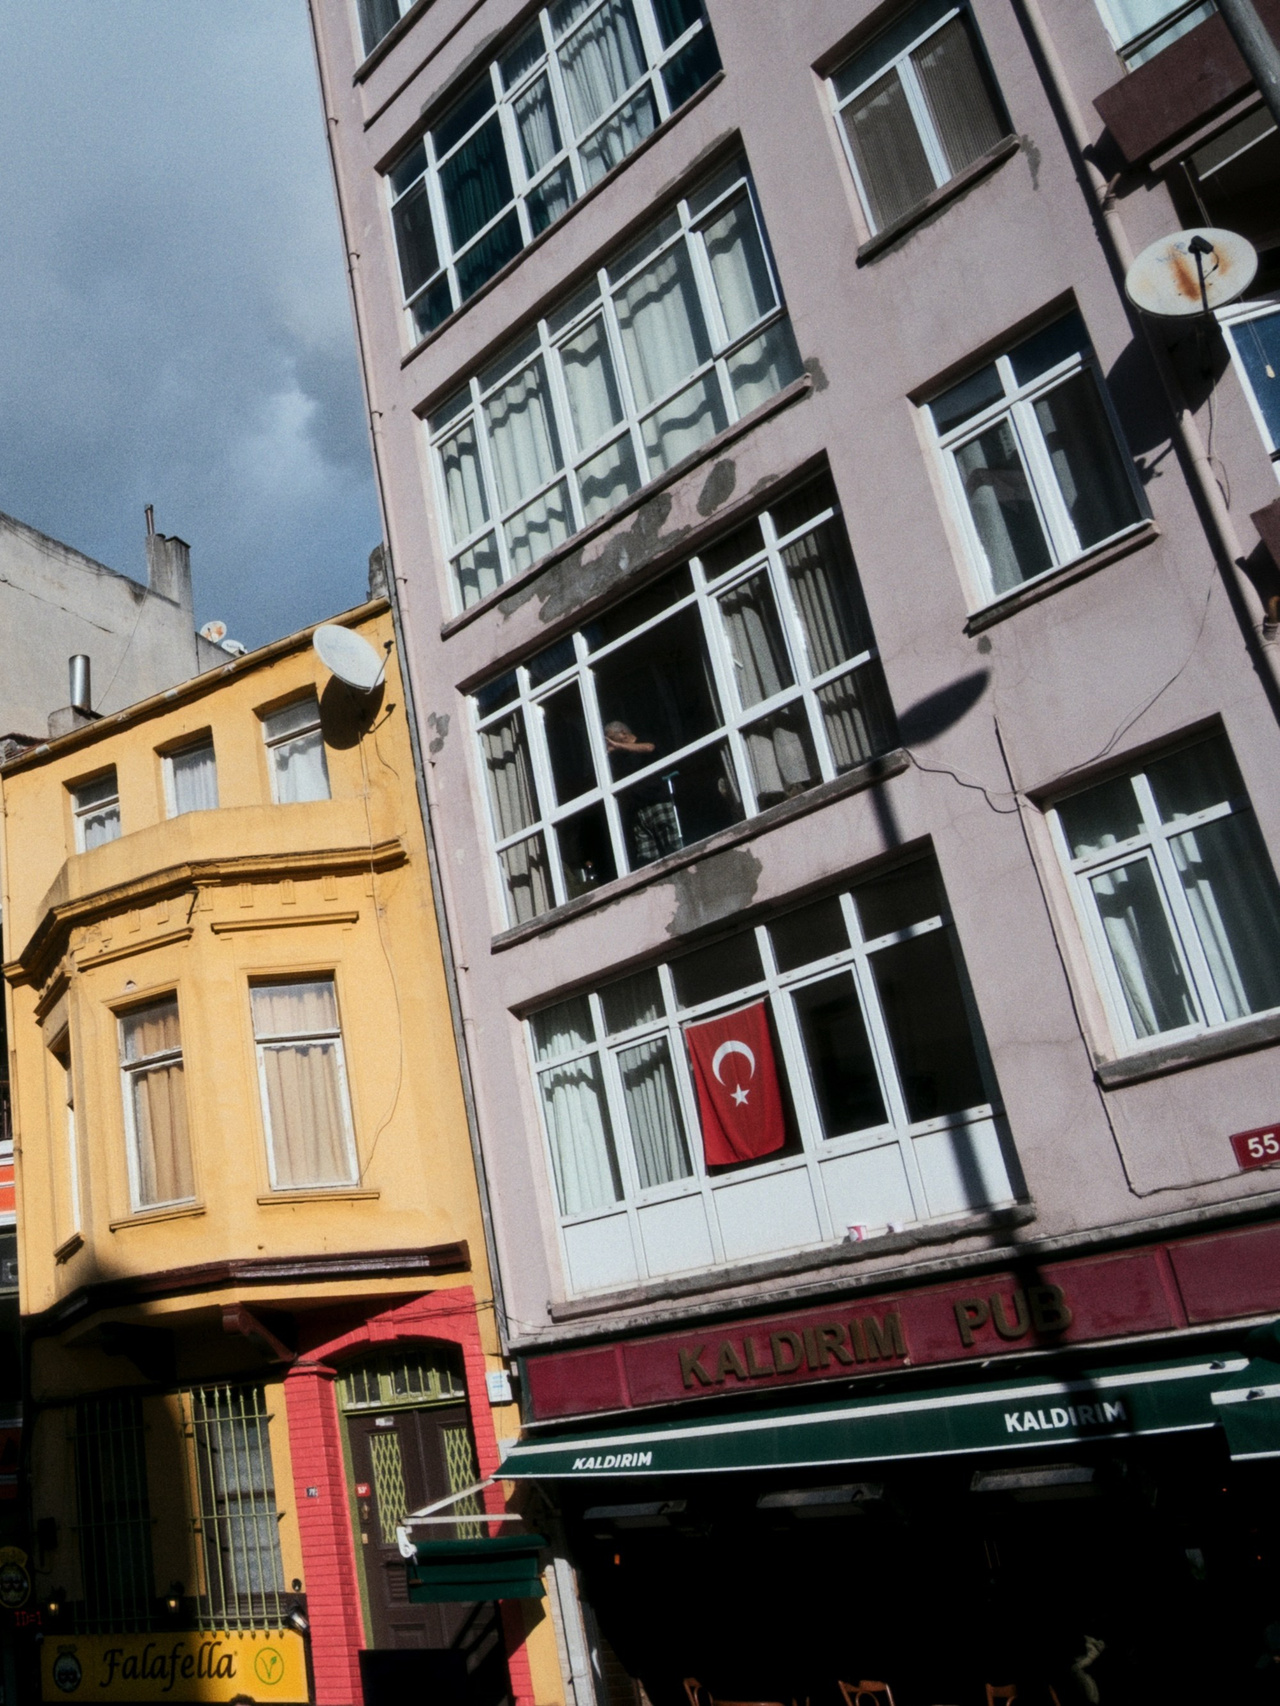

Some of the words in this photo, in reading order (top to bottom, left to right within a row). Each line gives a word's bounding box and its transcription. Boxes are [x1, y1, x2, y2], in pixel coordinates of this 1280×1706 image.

[1247, 1132, 1280, 1159] 55
[677, 1310, 908, 1388] KALDIRIM
[954, 1283, 1074, 1348] PUB
[1004, 1400, 1129, 1435] KALDIRIM
[572, 1451, 654, 1471] KALDIRIM
[99, 1640, 237, 1692] Falafella
